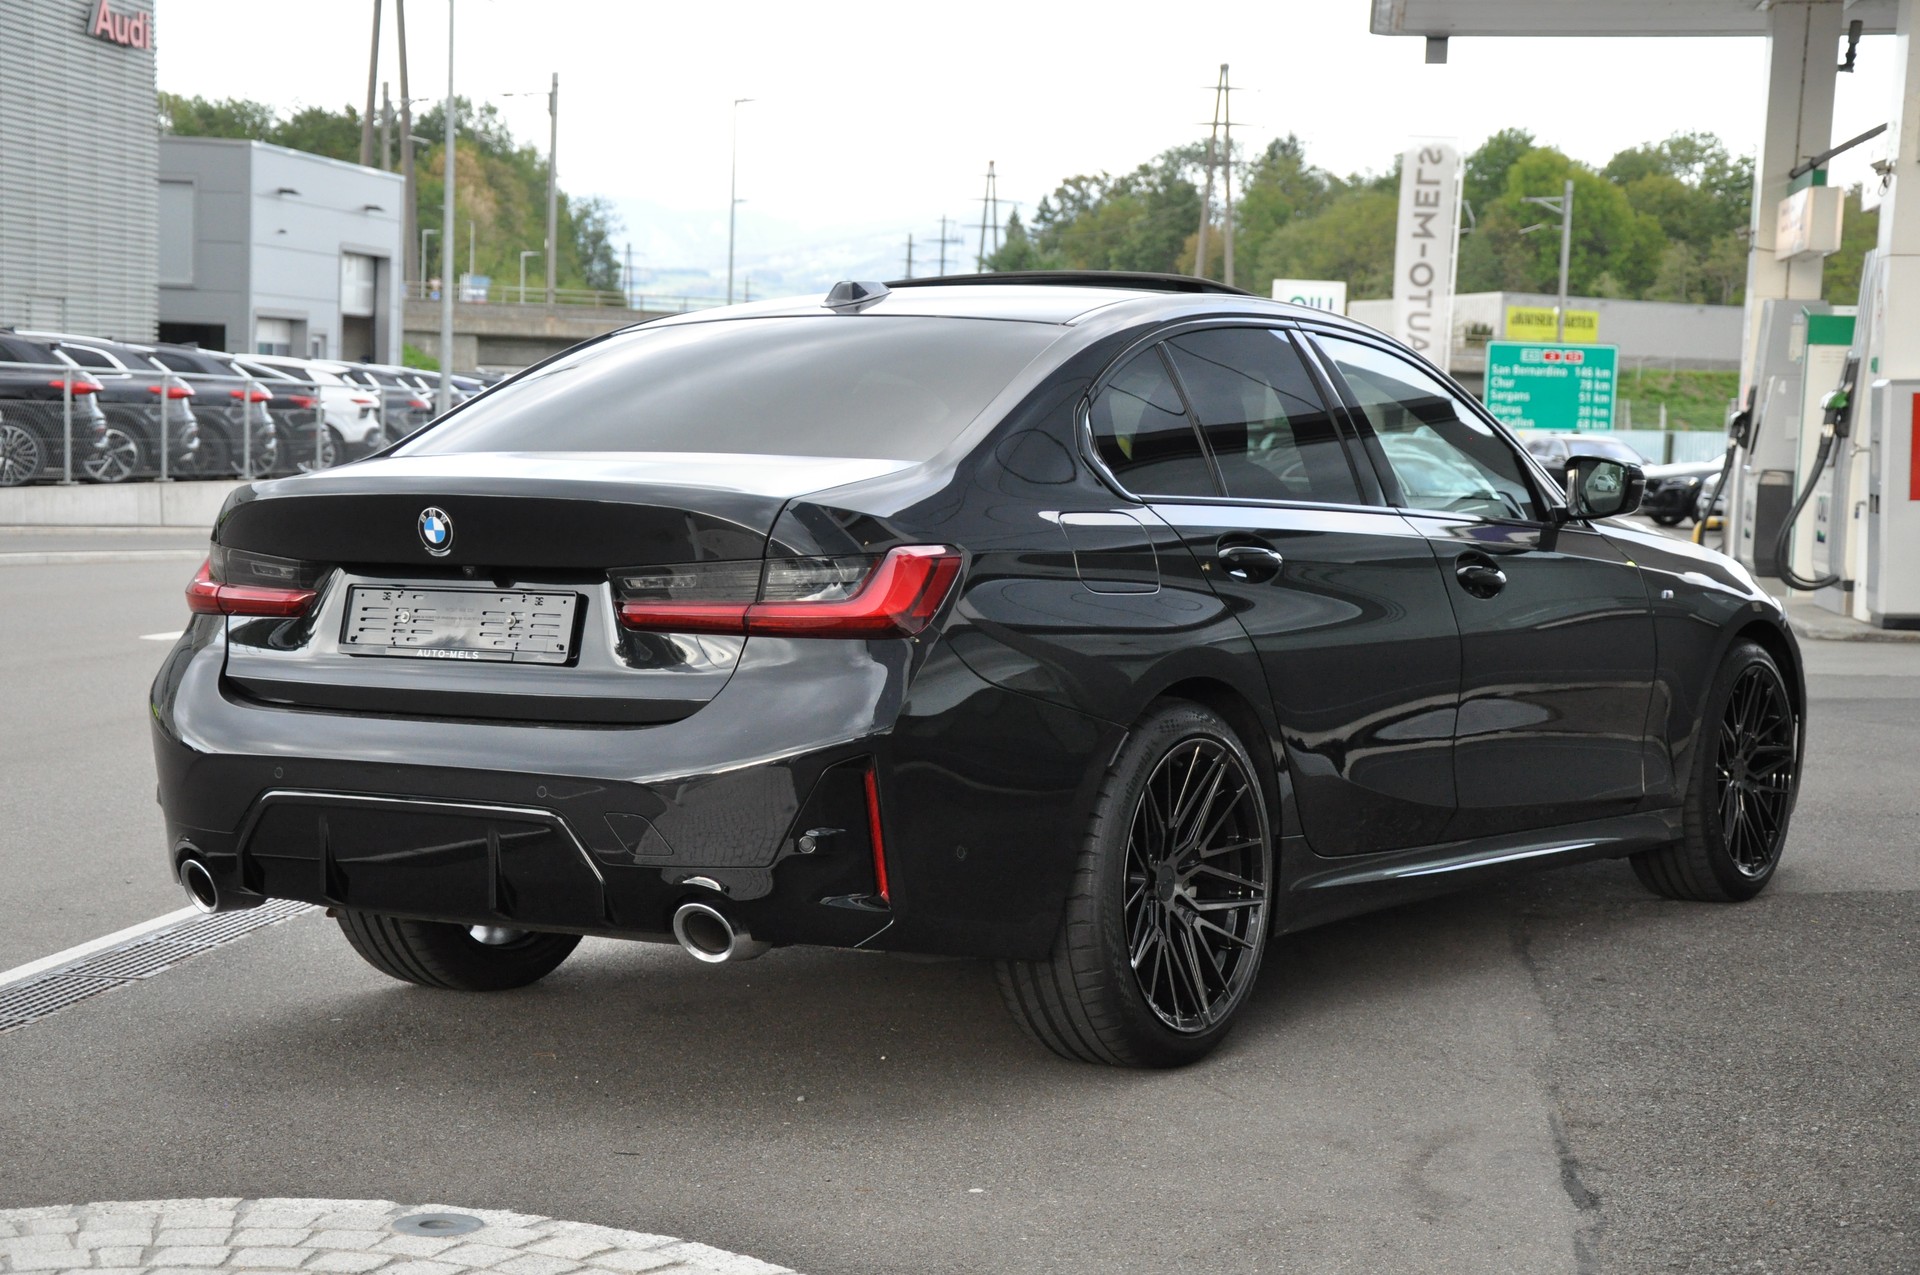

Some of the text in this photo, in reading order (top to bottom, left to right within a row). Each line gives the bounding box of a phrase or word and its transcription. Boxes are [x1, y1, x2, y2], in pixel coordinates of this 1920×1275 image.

[95, 0, 152, 49] Audi
[1492, 364, 1511, 375] San
[1514, 365, 1568, 377] Bernardino
[1595, 368, 1611, 379] km
[1491, 377, 1515, 388] Chur
[1594, 380, 1610, 391] km
[1490, 390, 1530, 403] Sargans
[1593, 393, 1609, 404] km
[1489, 403, 1522, 415] Glarus
[1592, 406, 1609, 417] km
[1592, 419, 1608, 429] km
[420, 509, 448, 523] BMW
[417, 649, 479, 660] AUTO-MELS
